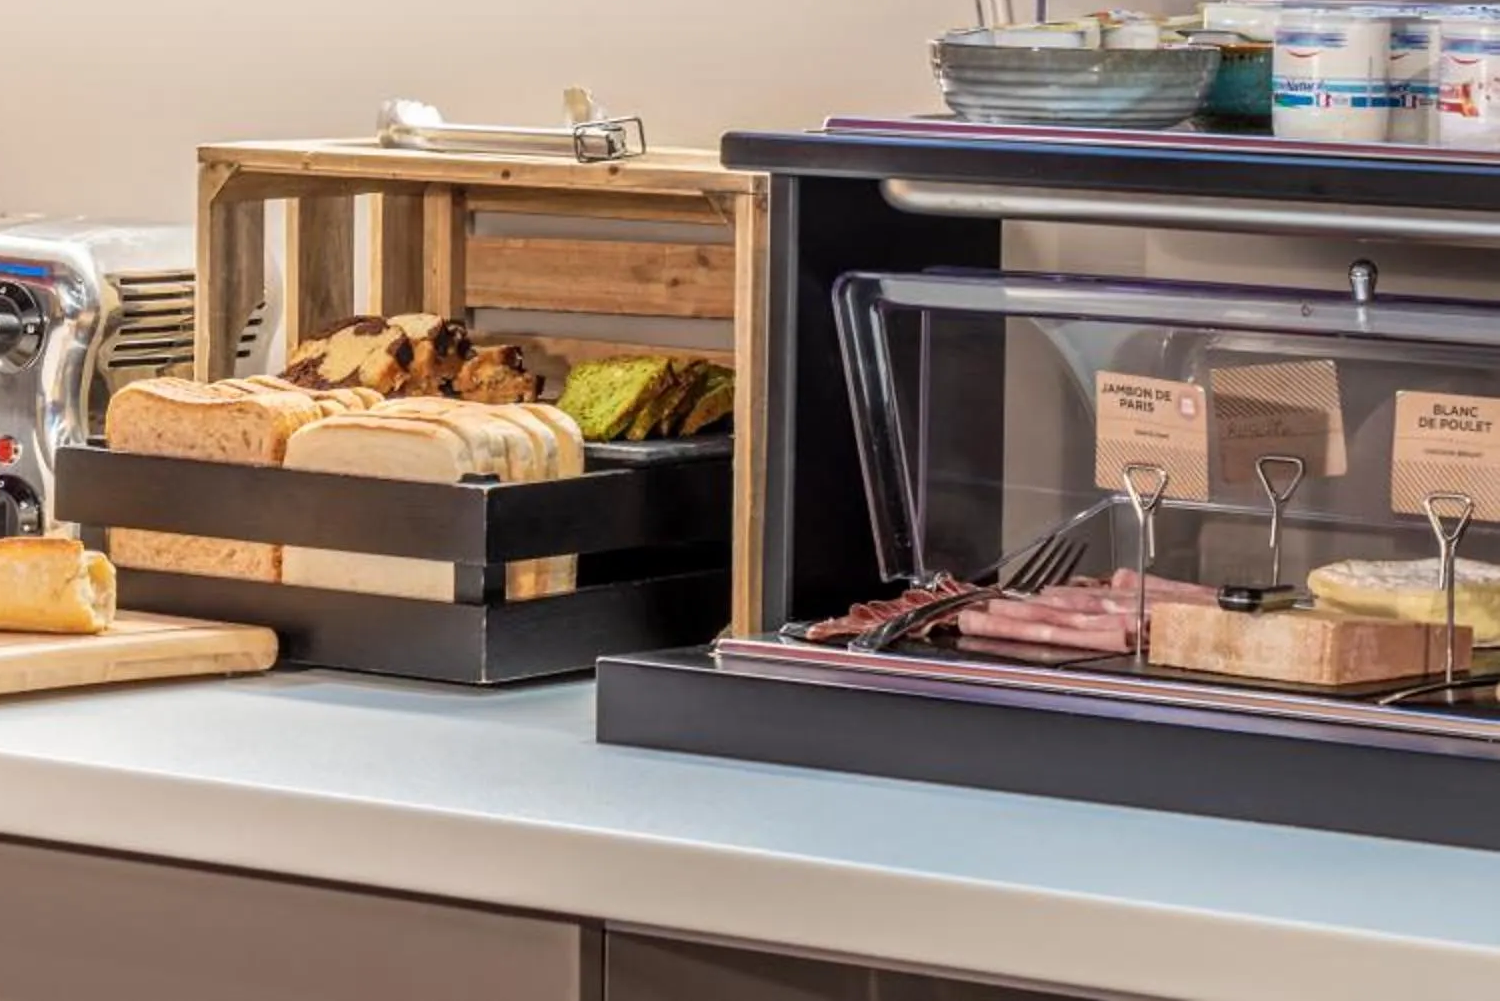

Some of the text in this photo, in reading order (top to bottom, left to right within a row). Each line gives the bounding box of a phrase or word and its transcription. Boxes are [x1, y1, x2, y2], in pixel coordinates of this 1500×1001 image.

[1101, 383, 1172, 402] JAMBON DE
[1119, 398, 1154, 412] PARIS
[1433, 404, 1479, 418] BLANC
[1418, 416, 1493, 434] DE POULET
